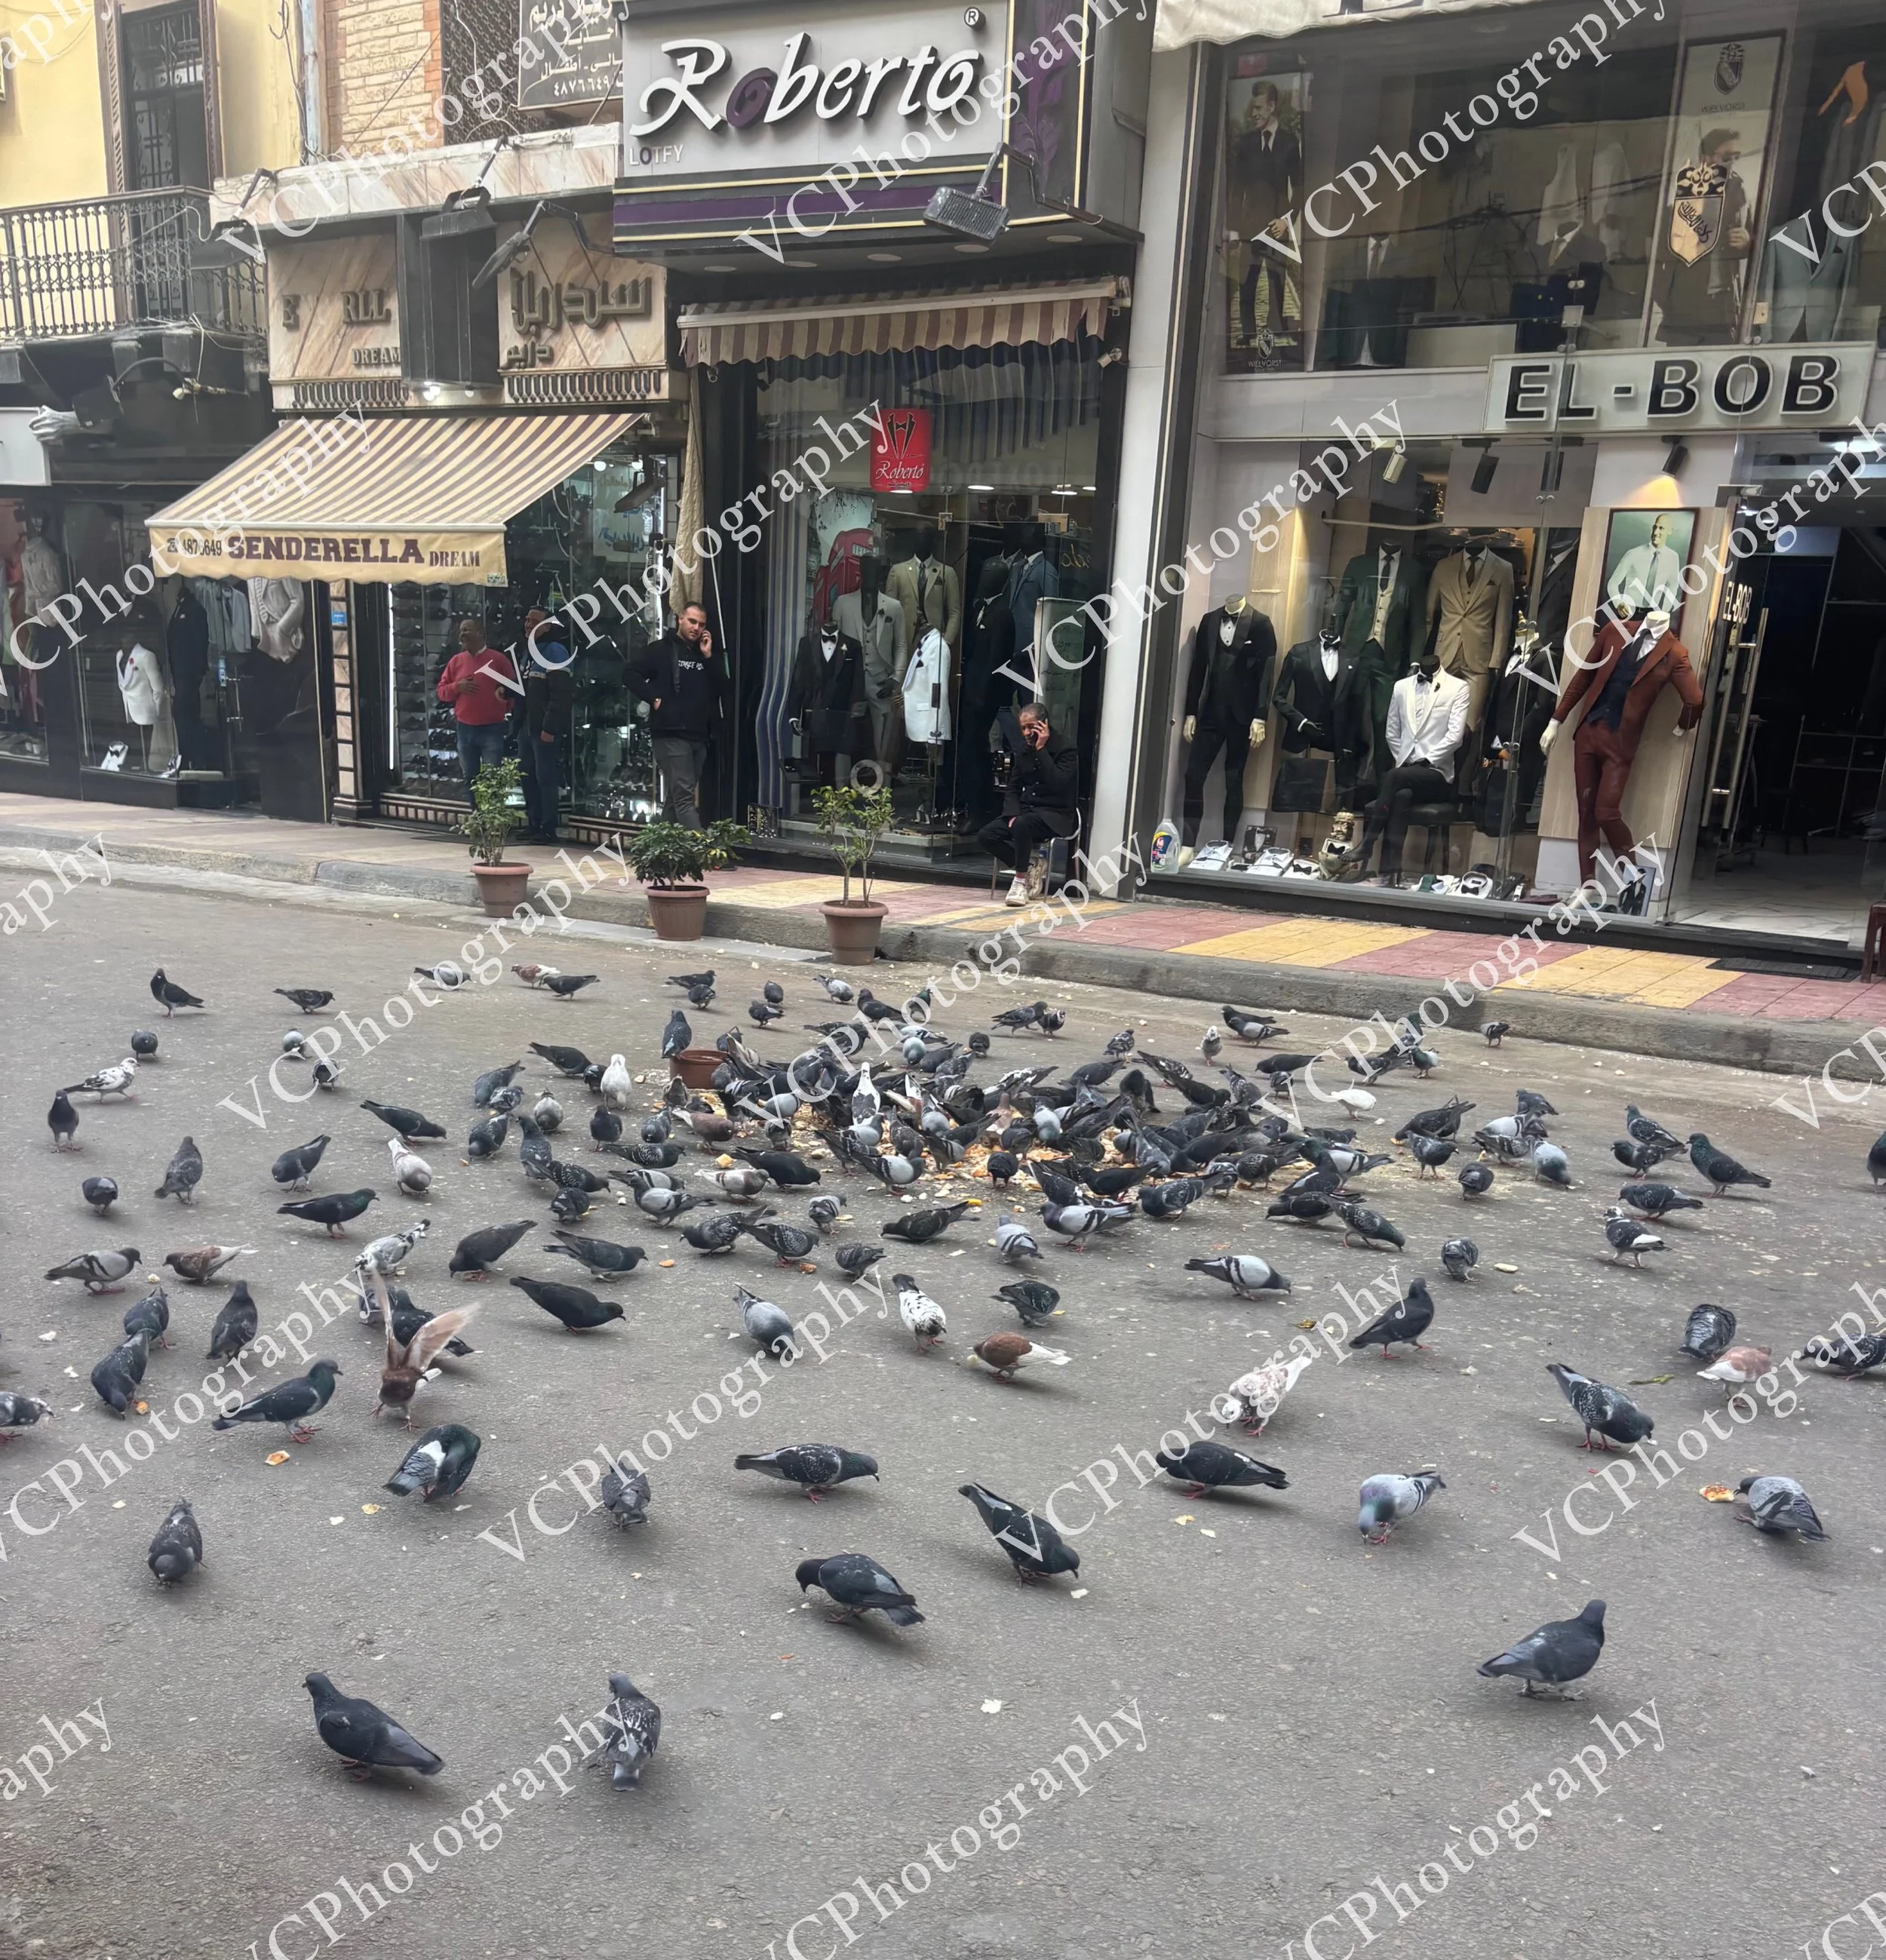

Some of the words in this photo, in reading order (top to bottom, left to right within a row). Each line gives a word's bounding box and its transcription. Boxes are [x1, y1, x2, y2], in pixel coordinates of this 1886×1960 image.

[629, 31, 984, 138] Roberto
[629, 145, 685, 167] LOTFY
[352, 347, 401, 367] DREAM
[876, 461, 925, 480] Roberto
[228, 536, 425, 564] SENDERELLA
[428, 551, 481, 567] DREAM
[1722, 581, 1753, 625] EL-BOB
